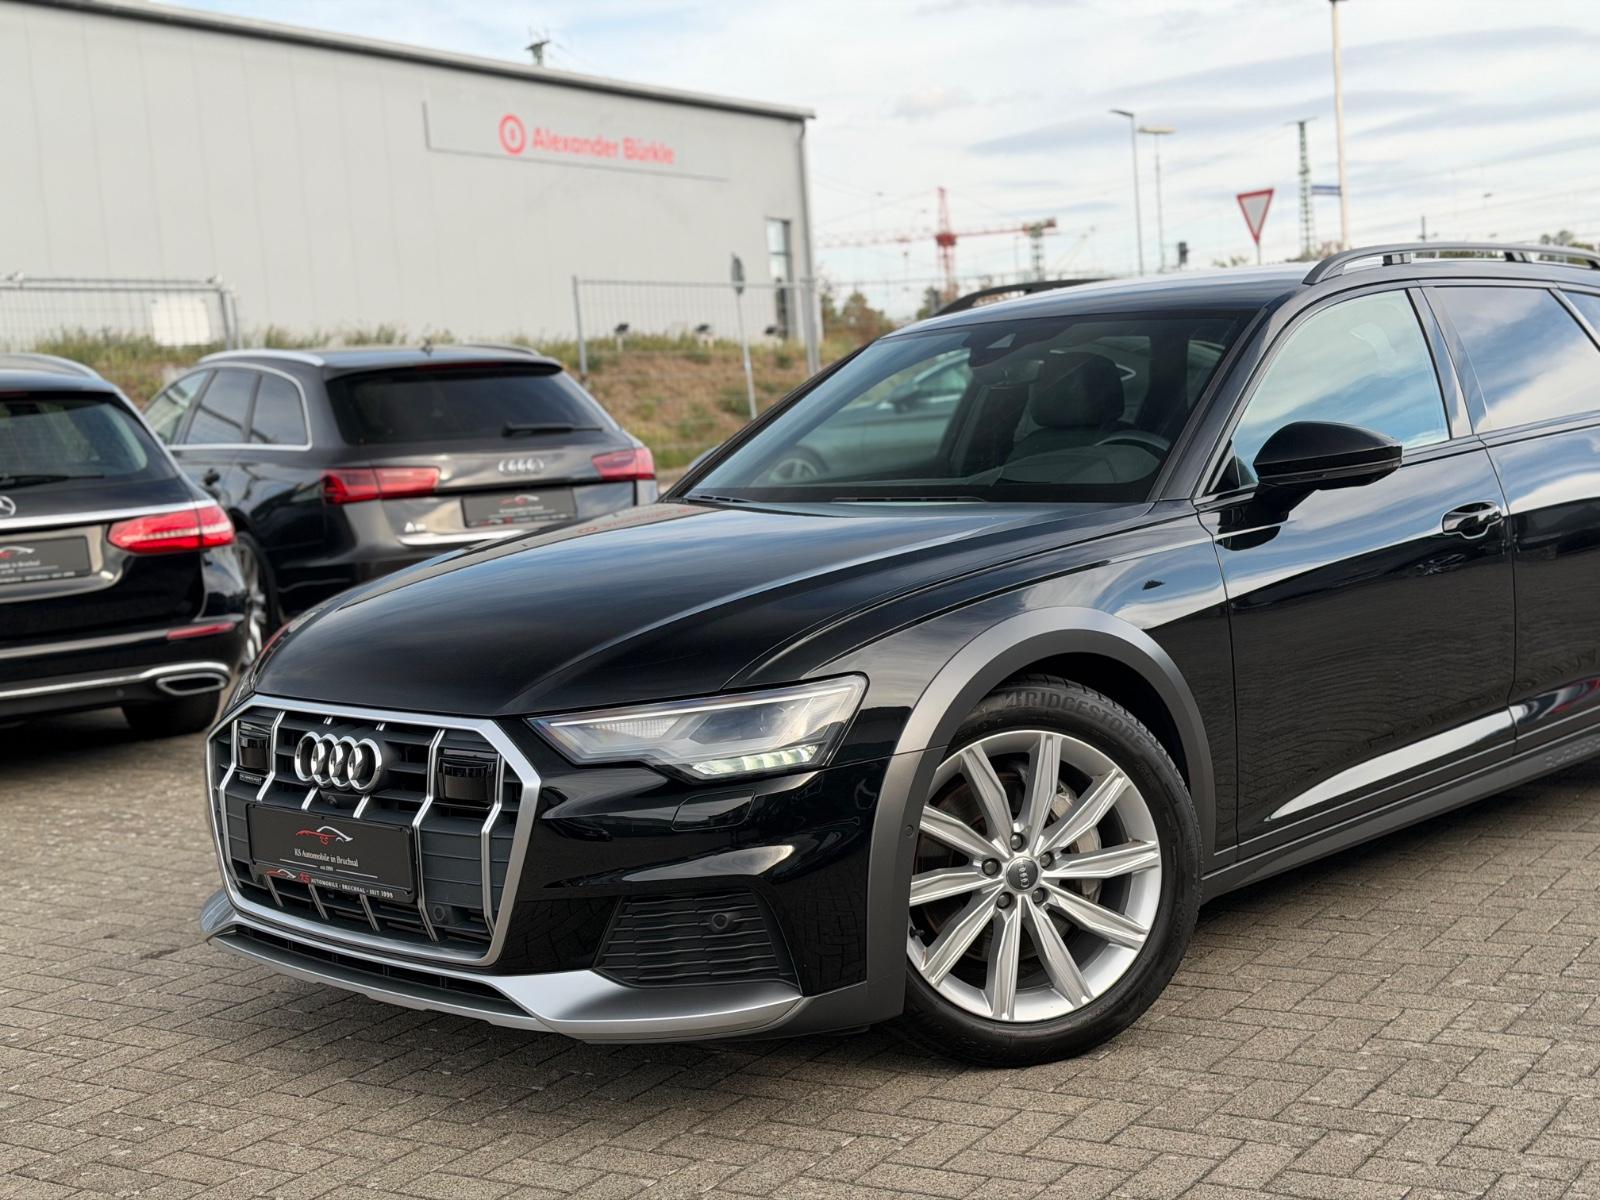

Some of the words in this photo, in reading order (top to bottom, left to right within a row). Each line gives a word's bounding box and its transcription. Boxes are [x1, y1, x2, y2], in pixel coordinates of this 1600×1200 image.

[533, 127, 618, 158] Alexander
[294, 848, 302, 857] KS
[302, 849, 330, 862] Automobile
[331, 855, 337, 863] in
